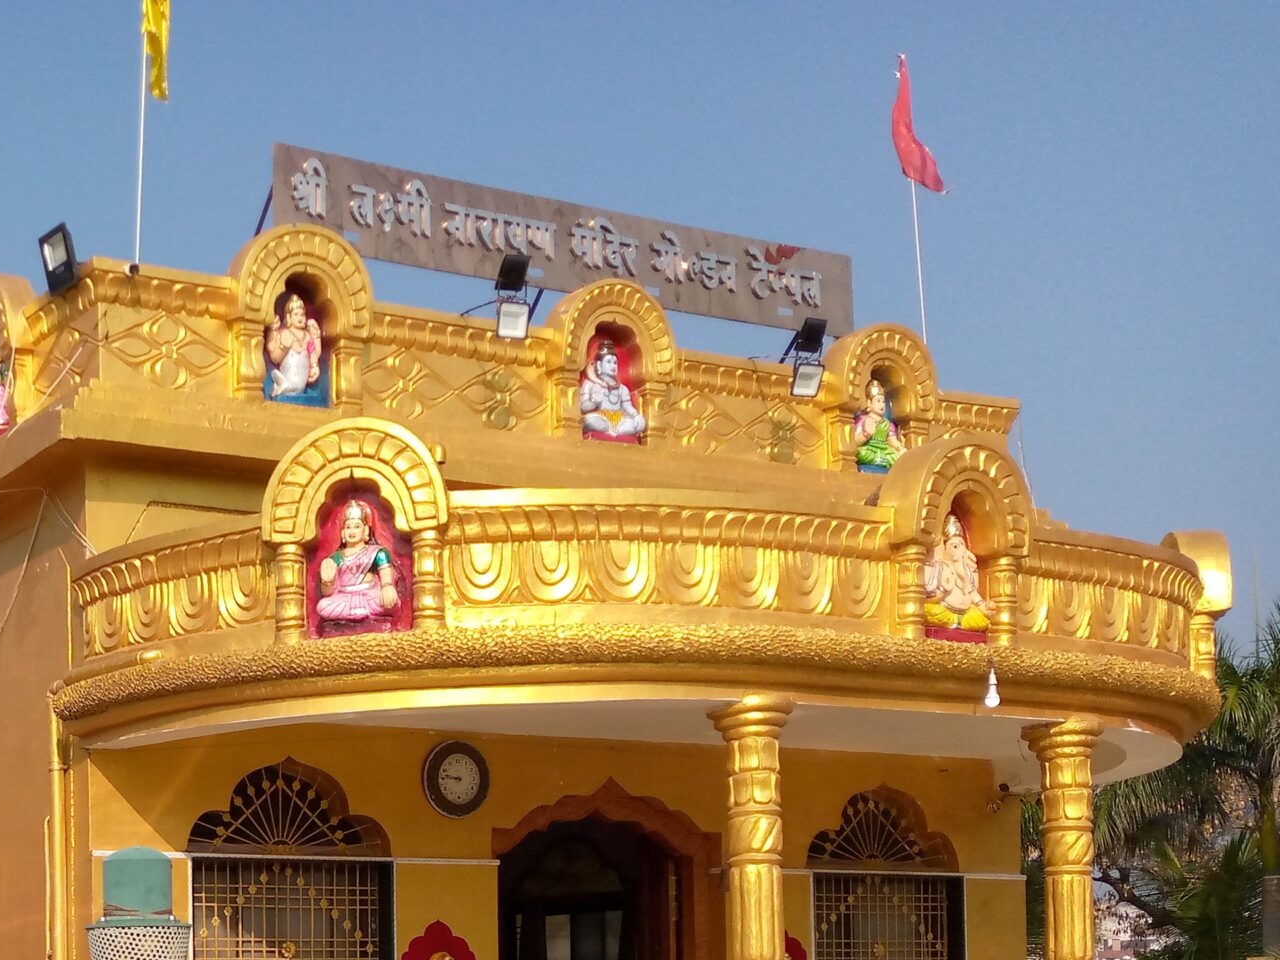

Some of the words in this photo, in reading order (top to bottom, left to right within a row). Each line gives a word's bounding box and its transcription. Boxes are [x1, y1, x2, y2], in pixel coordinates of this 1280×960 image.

[291, 157, 328, 219] श्री
[349, 178, 433, 239] लक्ष्मी
[442, 202, 558, 261] नारायण
[569, 216, 639, 277] मंदिर
[649, 230, 738, 294] गोल्डन
[745, 246, 822, 308] टेम्पल
